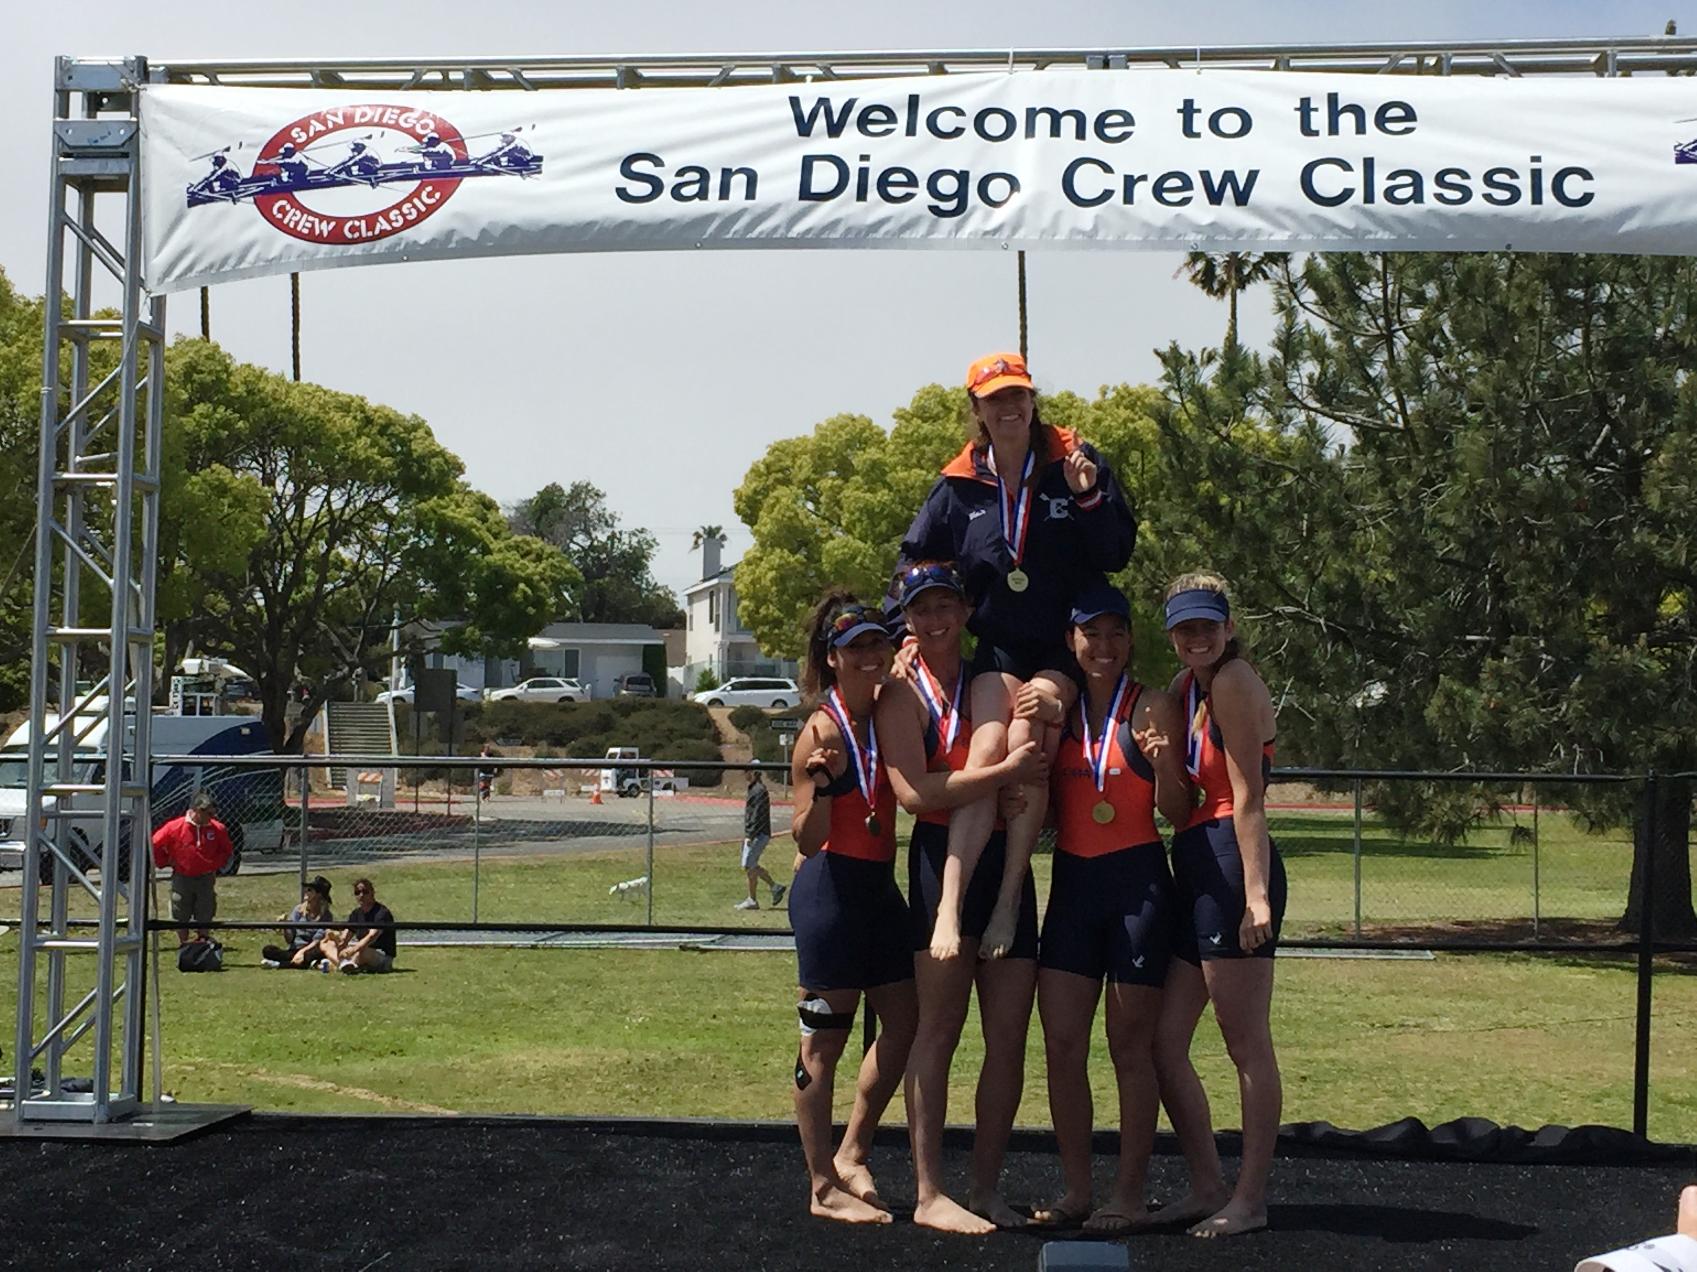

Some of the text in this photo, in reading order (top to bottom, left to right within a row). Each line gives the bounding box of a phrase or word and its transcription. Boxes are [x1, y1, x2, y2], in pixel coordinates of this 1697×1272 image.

[291, 107, 435, 143] SAN DIEGO
[788, 92, 1418, 144] Welcome to the
[615, 152, 1595, 219] San Diego Crew Classic
[272, 186, 441, 239] CREW CLASSIC
